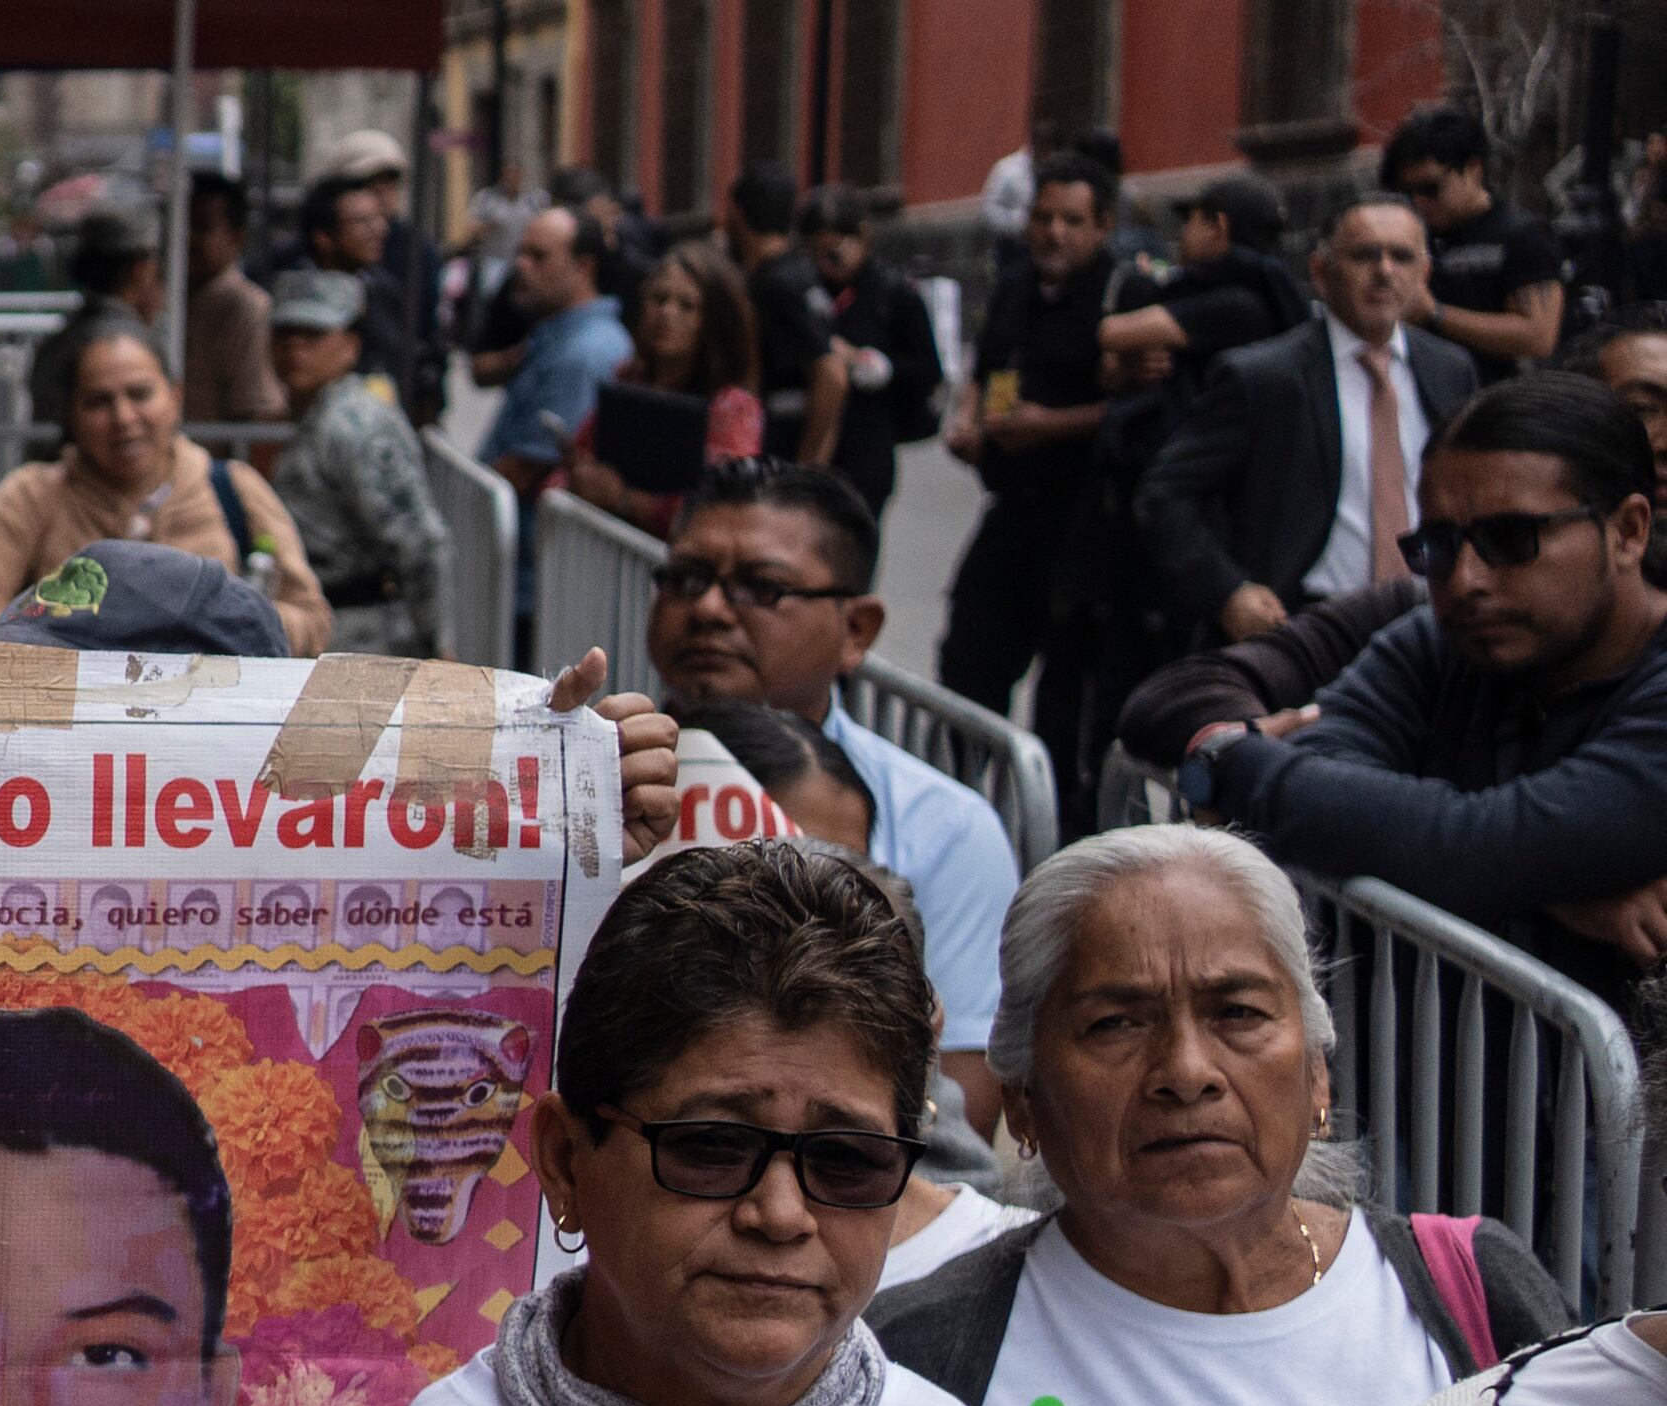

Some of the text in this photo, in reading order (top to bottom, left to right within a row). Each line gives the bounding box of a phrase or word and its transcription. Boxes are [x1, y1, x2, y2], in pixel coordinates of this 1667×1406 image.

[91, 753, 541, 849] llevaron!
[107, 899, 219, 929] quiero
[236, 898, 329, 926] saber
[346, 898, 440, 928] dónde
[457, 899, 533, 927] está
